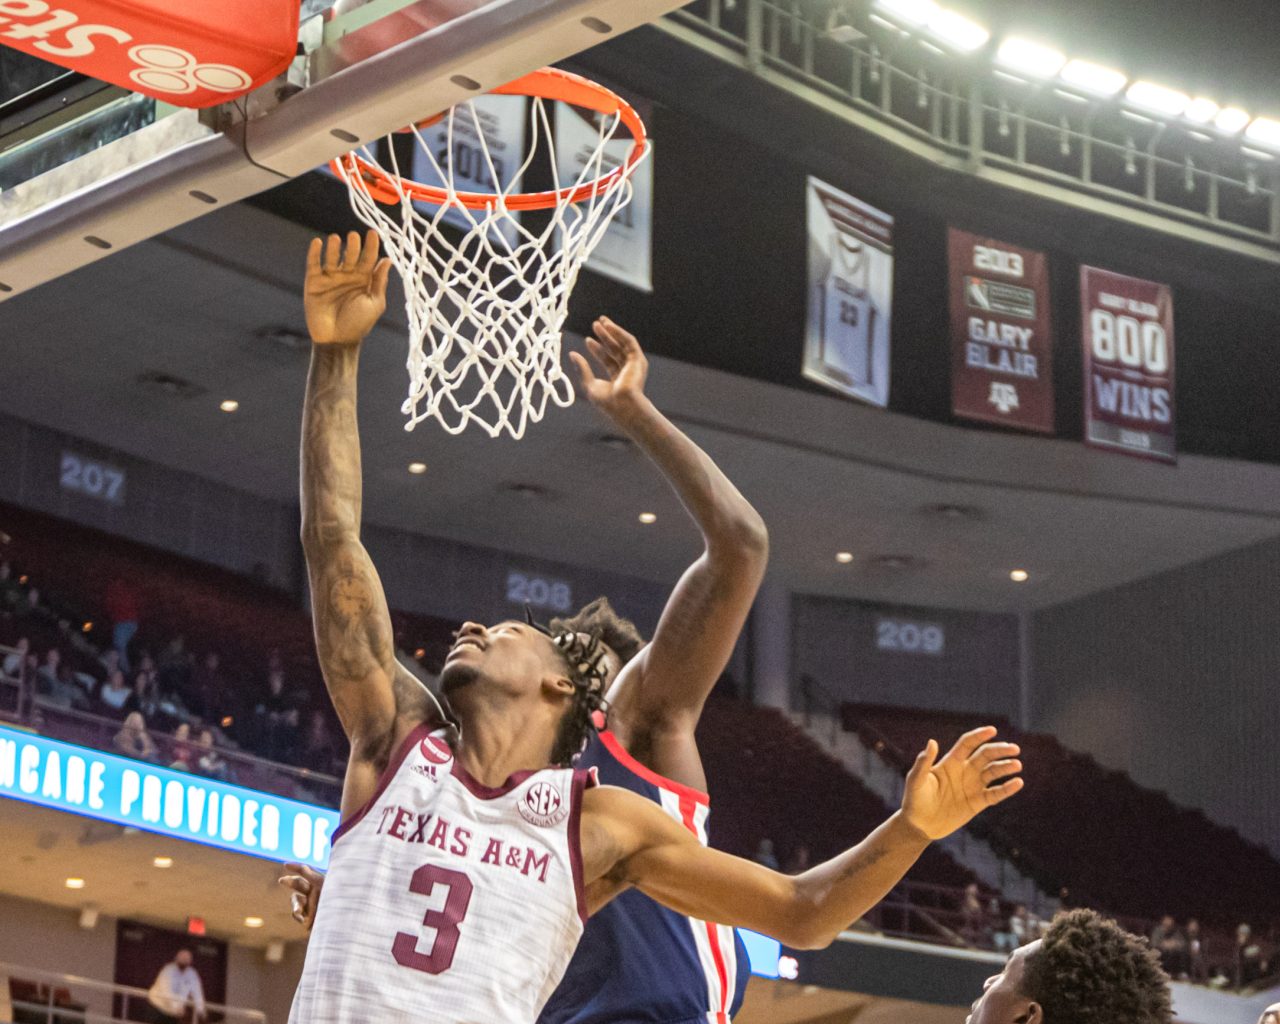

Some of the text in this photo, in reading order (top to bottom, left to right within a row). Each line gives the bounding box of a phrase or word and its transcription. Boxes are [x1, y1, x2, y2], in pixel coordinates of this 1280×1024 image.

[968, 317, 1033, 351] GARY
[1091, 309, 1169, 374] 800
[966, 341, 1039, 379] BLAIR
[1093, 375, 1171, 425] WINS
[61, 457, 124, 499] 207
[878, 621, 943, 652] 209
[120, 769, 280, 851] PROVIDER
[293, 812, 330, 862] OF
[526, 782, 560, 816] SEC
[376, 805, 552, 883] TEXAS A&M
[391, 863, 474, 975] 3
